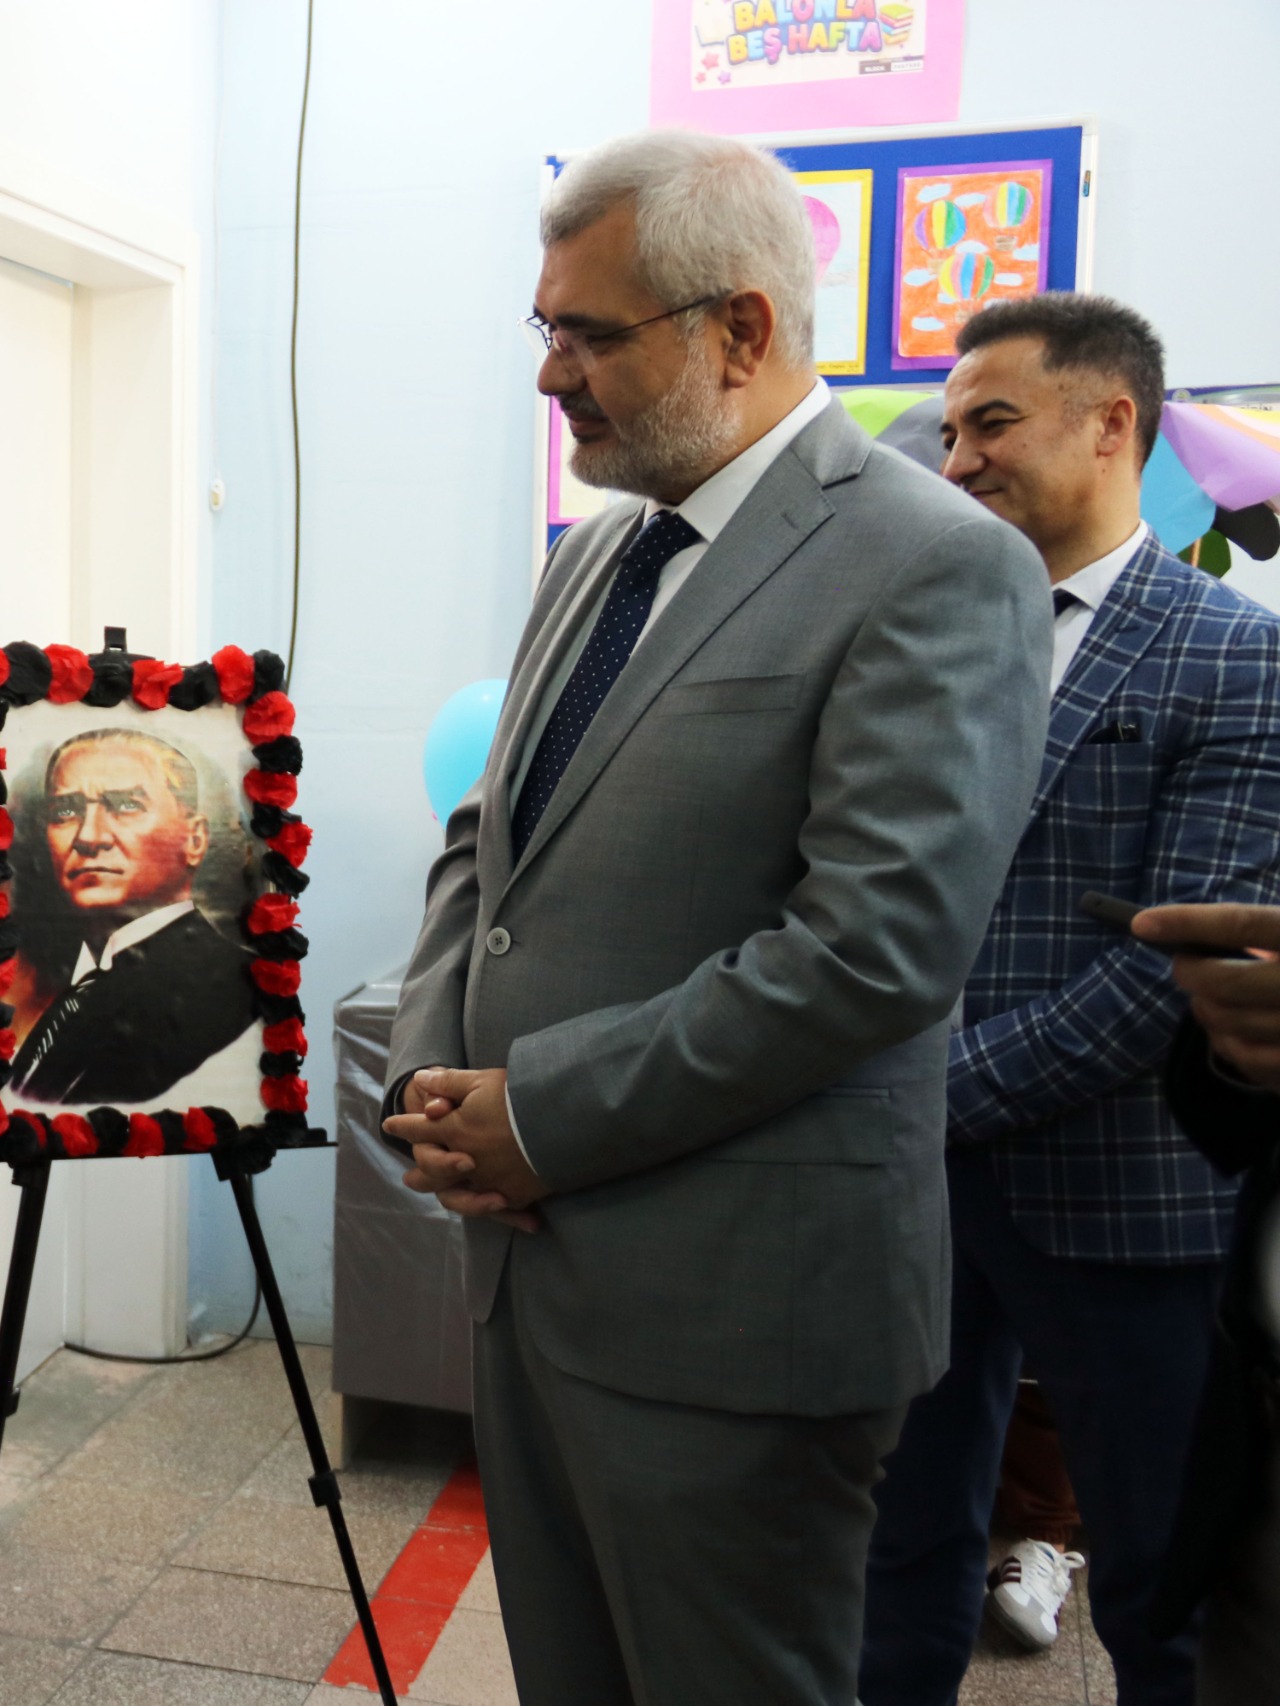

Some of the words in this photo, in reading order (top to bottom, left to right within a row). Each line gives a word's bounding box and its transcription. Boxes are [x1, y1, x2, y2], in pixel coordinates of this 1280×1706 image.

[731, 0, 877, 33] BALONLA
[726, 26, 781, 65] BEŞ
[787, 20, 882, 55] HAFTA
